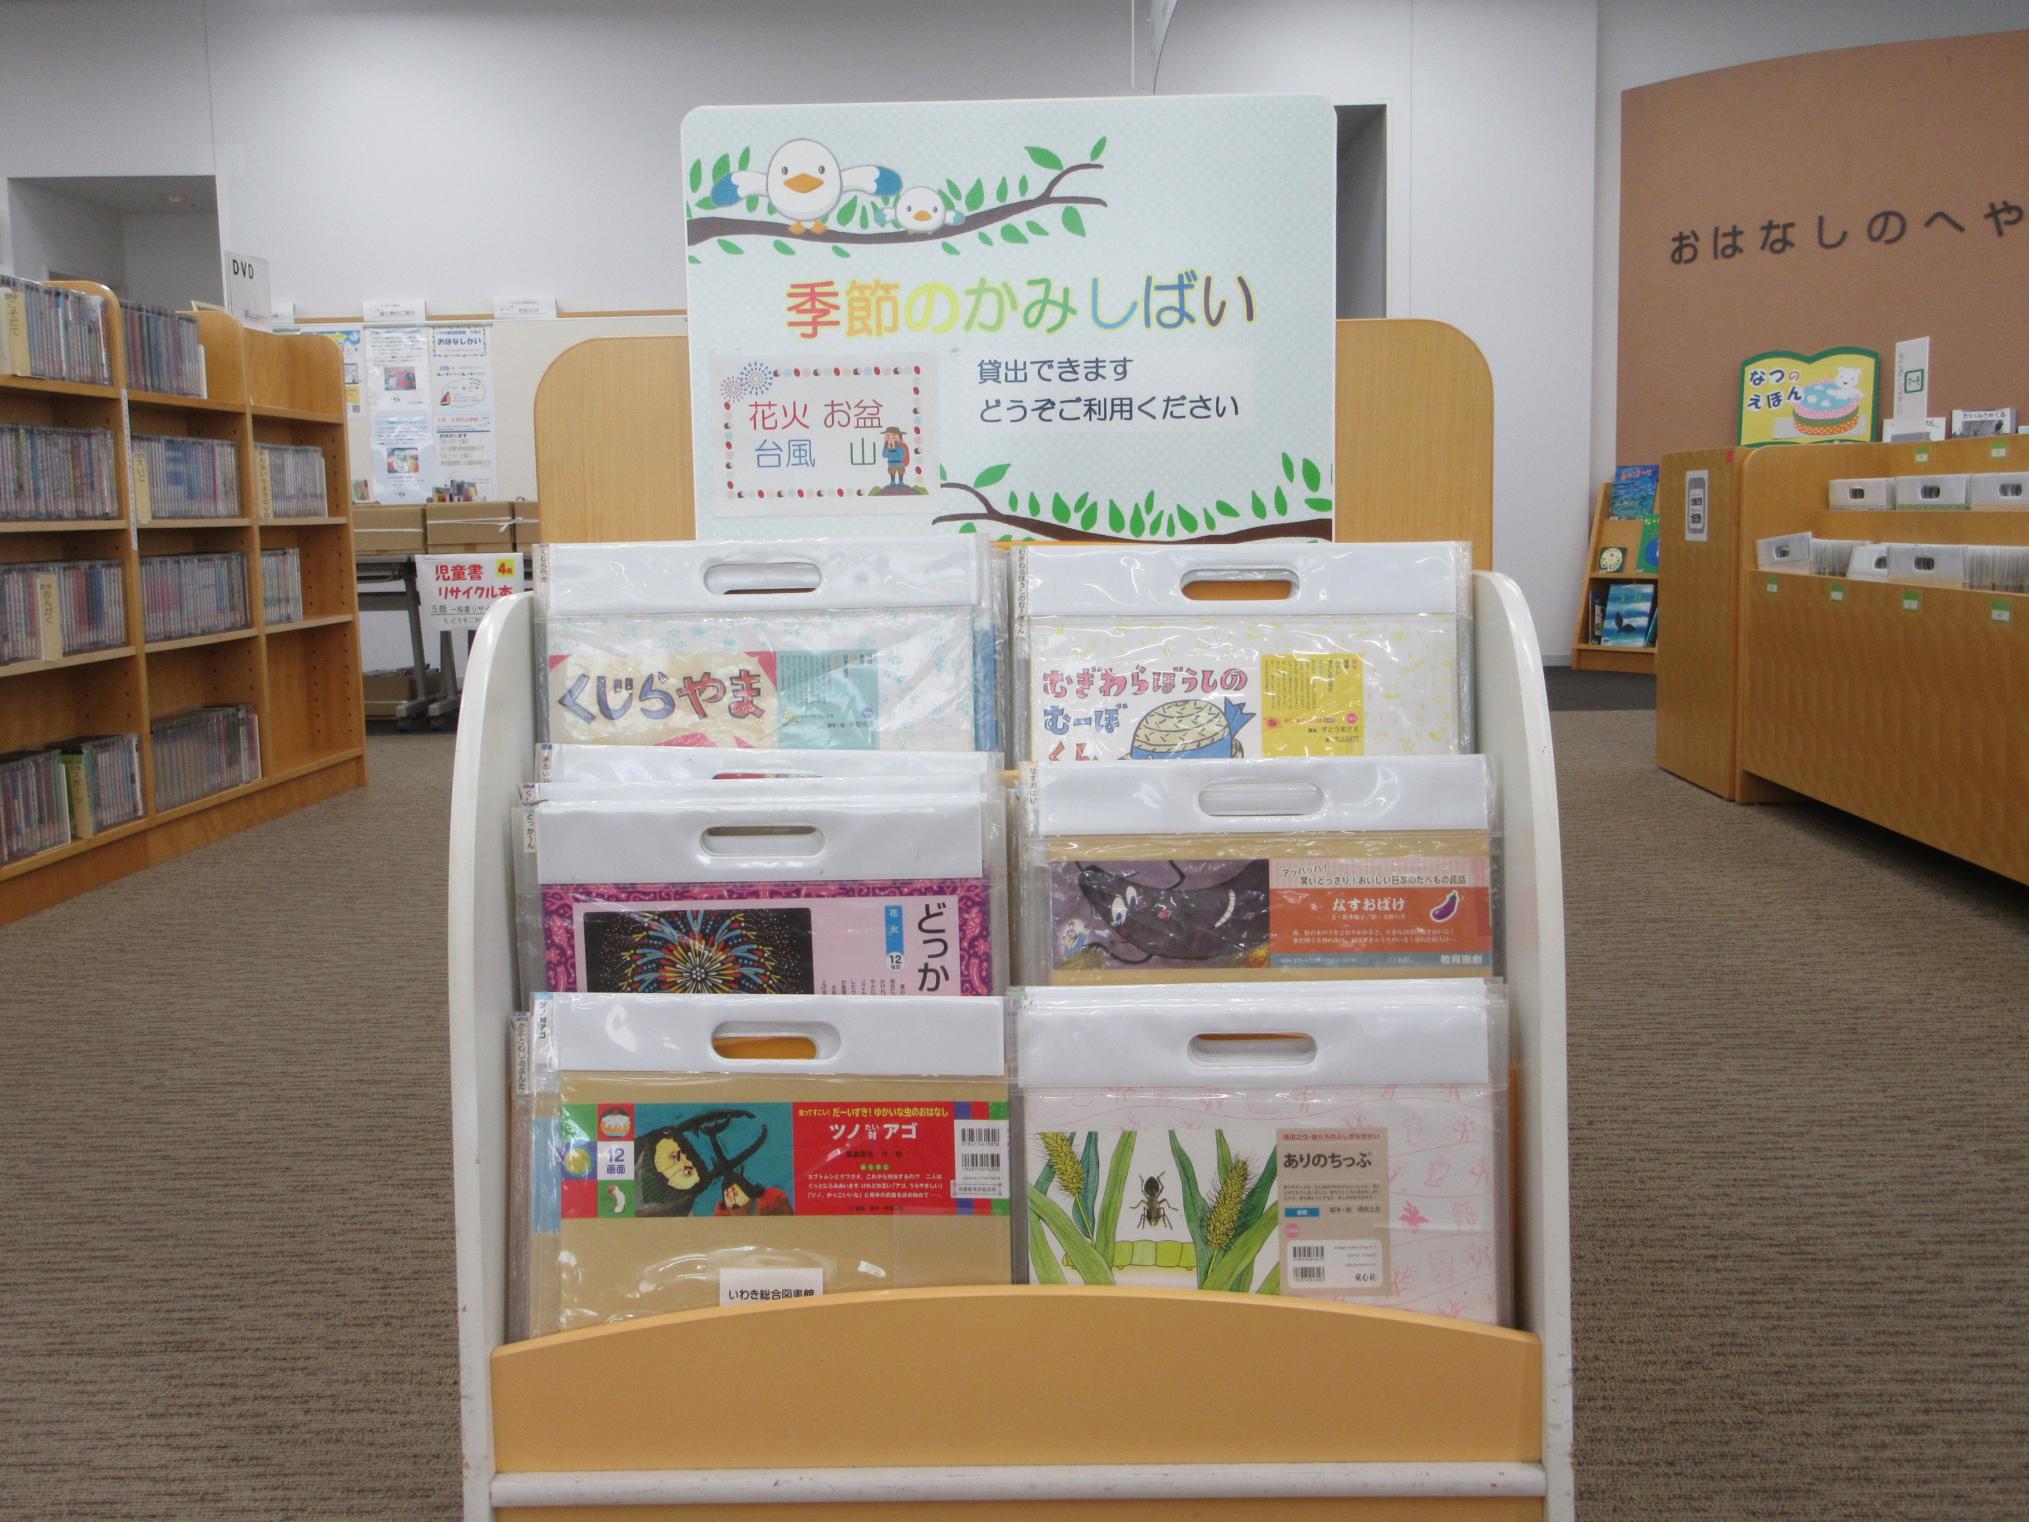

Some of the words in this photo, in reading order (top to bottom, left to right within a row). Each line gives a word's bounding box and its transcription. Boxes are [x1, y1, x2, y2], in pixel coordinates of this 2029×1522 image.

[1669, 200, 2025, 265] おはなしのへや
[232, 258, 254, 280] DVD
[786, 268, 1257, 340] 季節のかみしばい
[978, 356, 1134, 385] 貸出できます
[1749, 368, 1800, 387] なつの
[979, 393, 1241, 423] どうぞご利用ください
[1747, 386, 1802, 410] えほん
[748, 399, 811, 432] 花火
[822, 399, 884, 431] お盆
[754, 438, 816, 470] 台風
[850, 437, 877, 468] 山
[435, 564, 484, 582] 児童書
[438, 584, 513, 600] リサイクル本
[1043, 664, 1248, 699] むぎわらぼうしの
[558, 668, 766, 724] くじらやま
[1043, 703, 1128, 735] むーぼ
[1332, 897, 1406, 913] なすおばけ
[889, 908, 899, 936] 花火
[889, 955, 902, 964] 12
[918, 902, 950, 992] どっか
[873, 1107, 949, 1118] ゆかいな虫のおはなし
[606, 1148, 625, 1163] 12
[1283, 1151, 1373, 1169] ありのちっぷ
